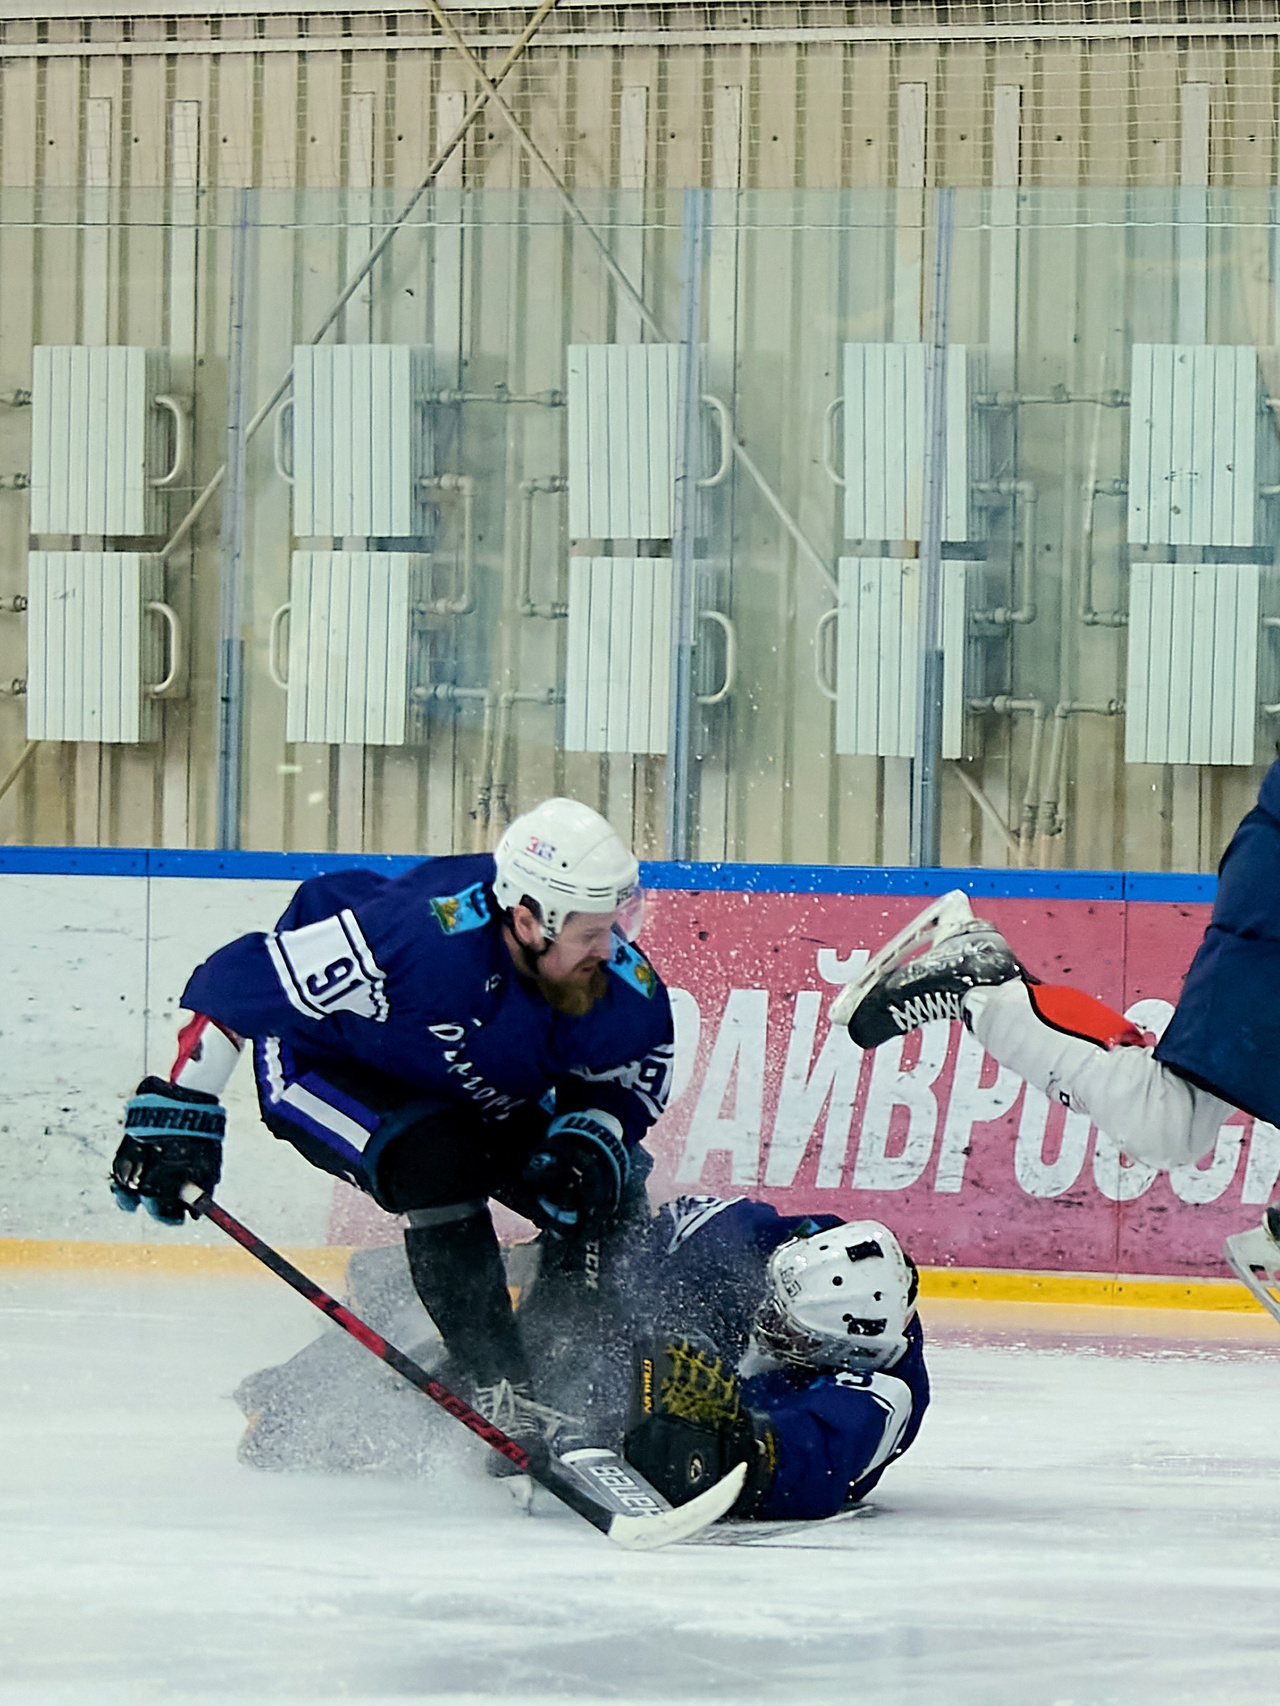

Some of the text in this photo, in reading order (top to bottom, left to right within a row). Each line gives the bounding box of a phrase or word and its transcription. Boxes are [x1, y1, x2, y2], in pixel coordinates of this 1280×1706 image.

[306, 957, 366, 1008] 91
[125, 1107, 226, 1133] WARRIO
[585, 1241, 599, 1290] CCM
